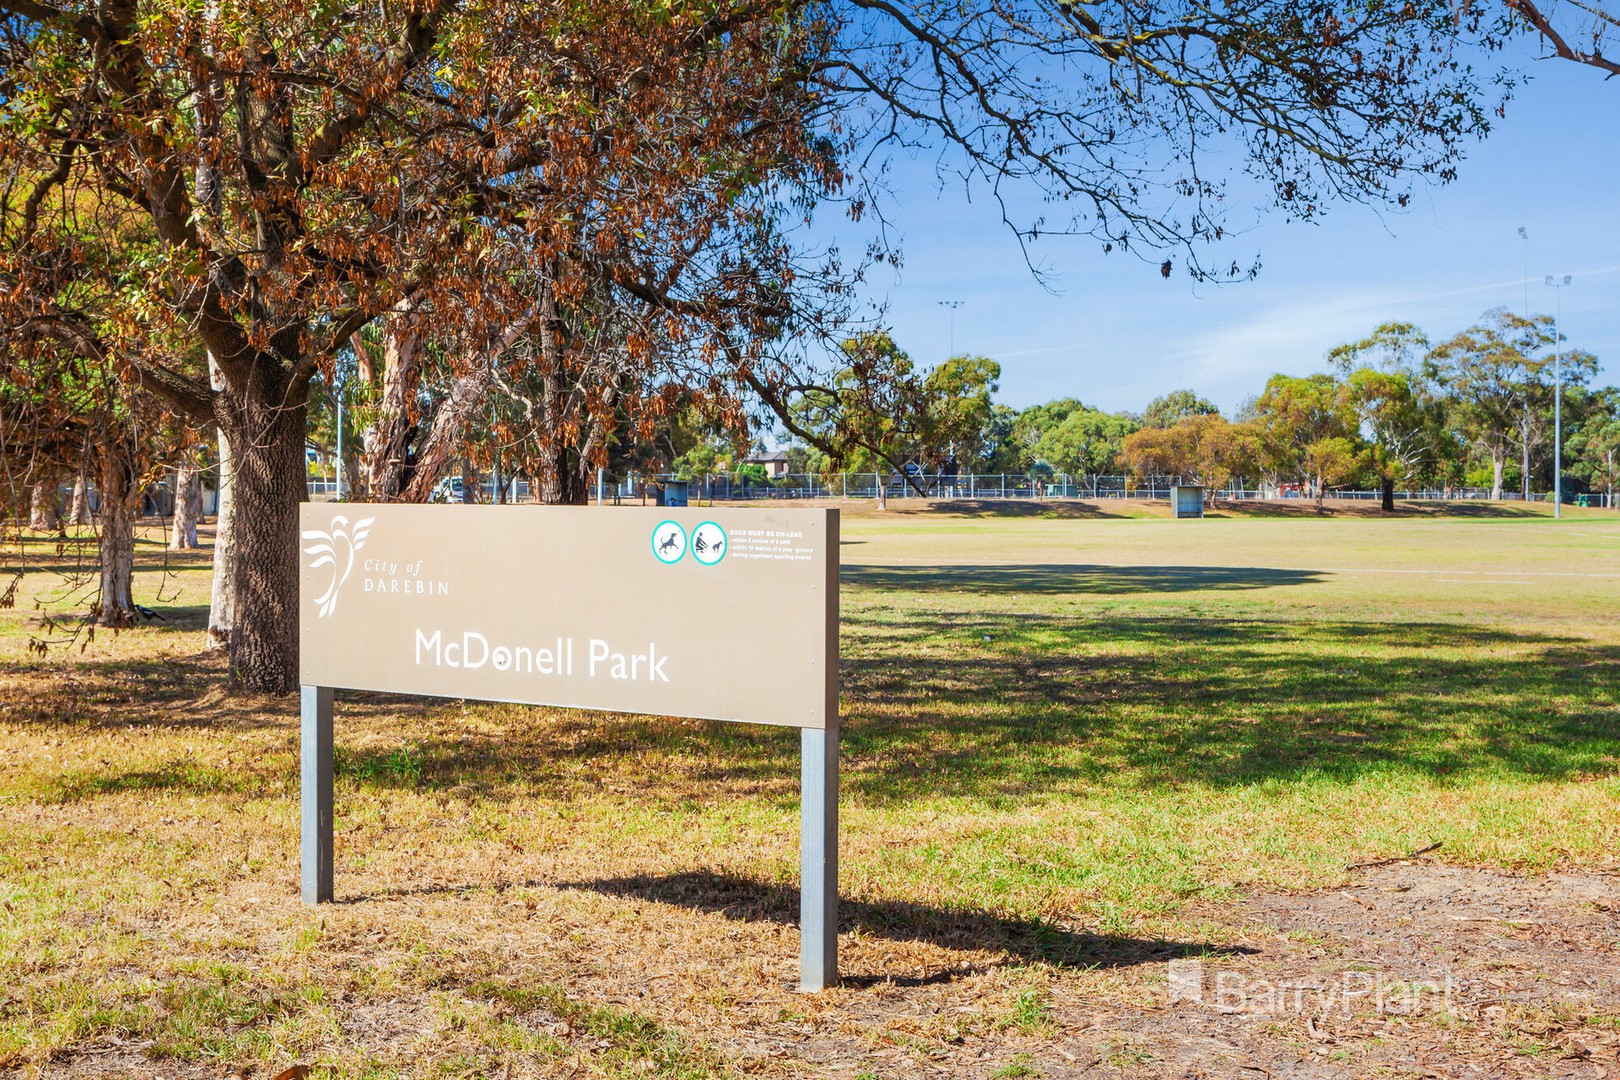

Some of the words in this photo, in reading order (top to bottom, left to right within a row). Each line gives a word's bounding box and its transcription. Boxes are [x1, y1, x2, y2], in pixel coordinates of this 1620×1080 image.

[364, 559, 398, 575] City
[406, 560, 424, 576] of
[364, 578, 449, 595] DAREBIN
[415, 628, 574, 676] McDonell
[589, 638, 671, 682] Park
